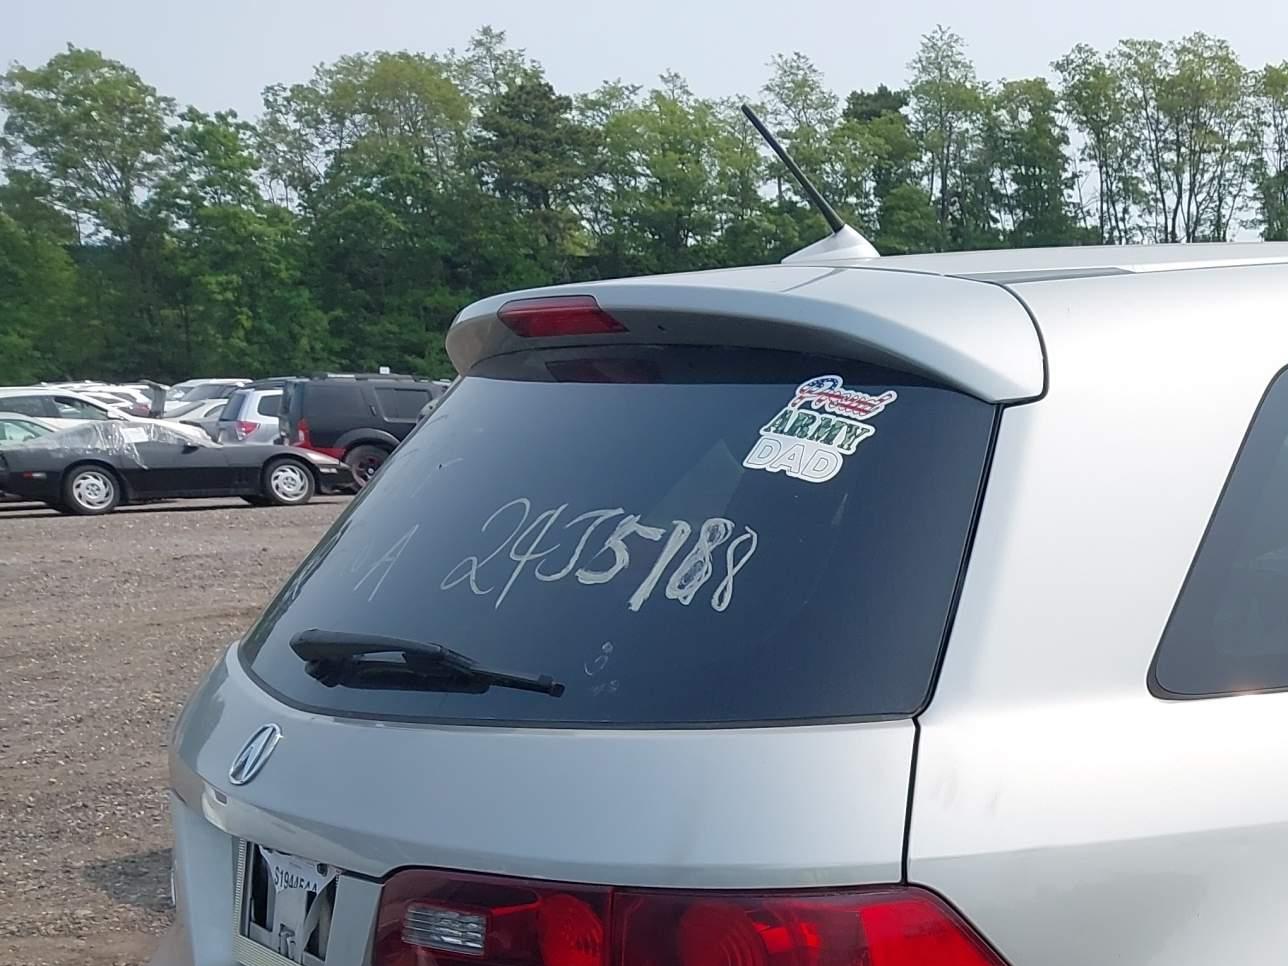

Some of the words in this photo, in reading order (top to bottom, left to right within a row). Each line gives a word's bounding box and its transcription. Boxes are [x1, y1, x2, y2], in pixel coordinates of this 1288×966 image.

[792, 377, 893, 416] Proud
[764, 409, 870, 451] ARMY
[747, 437, 839, 479] DAD
